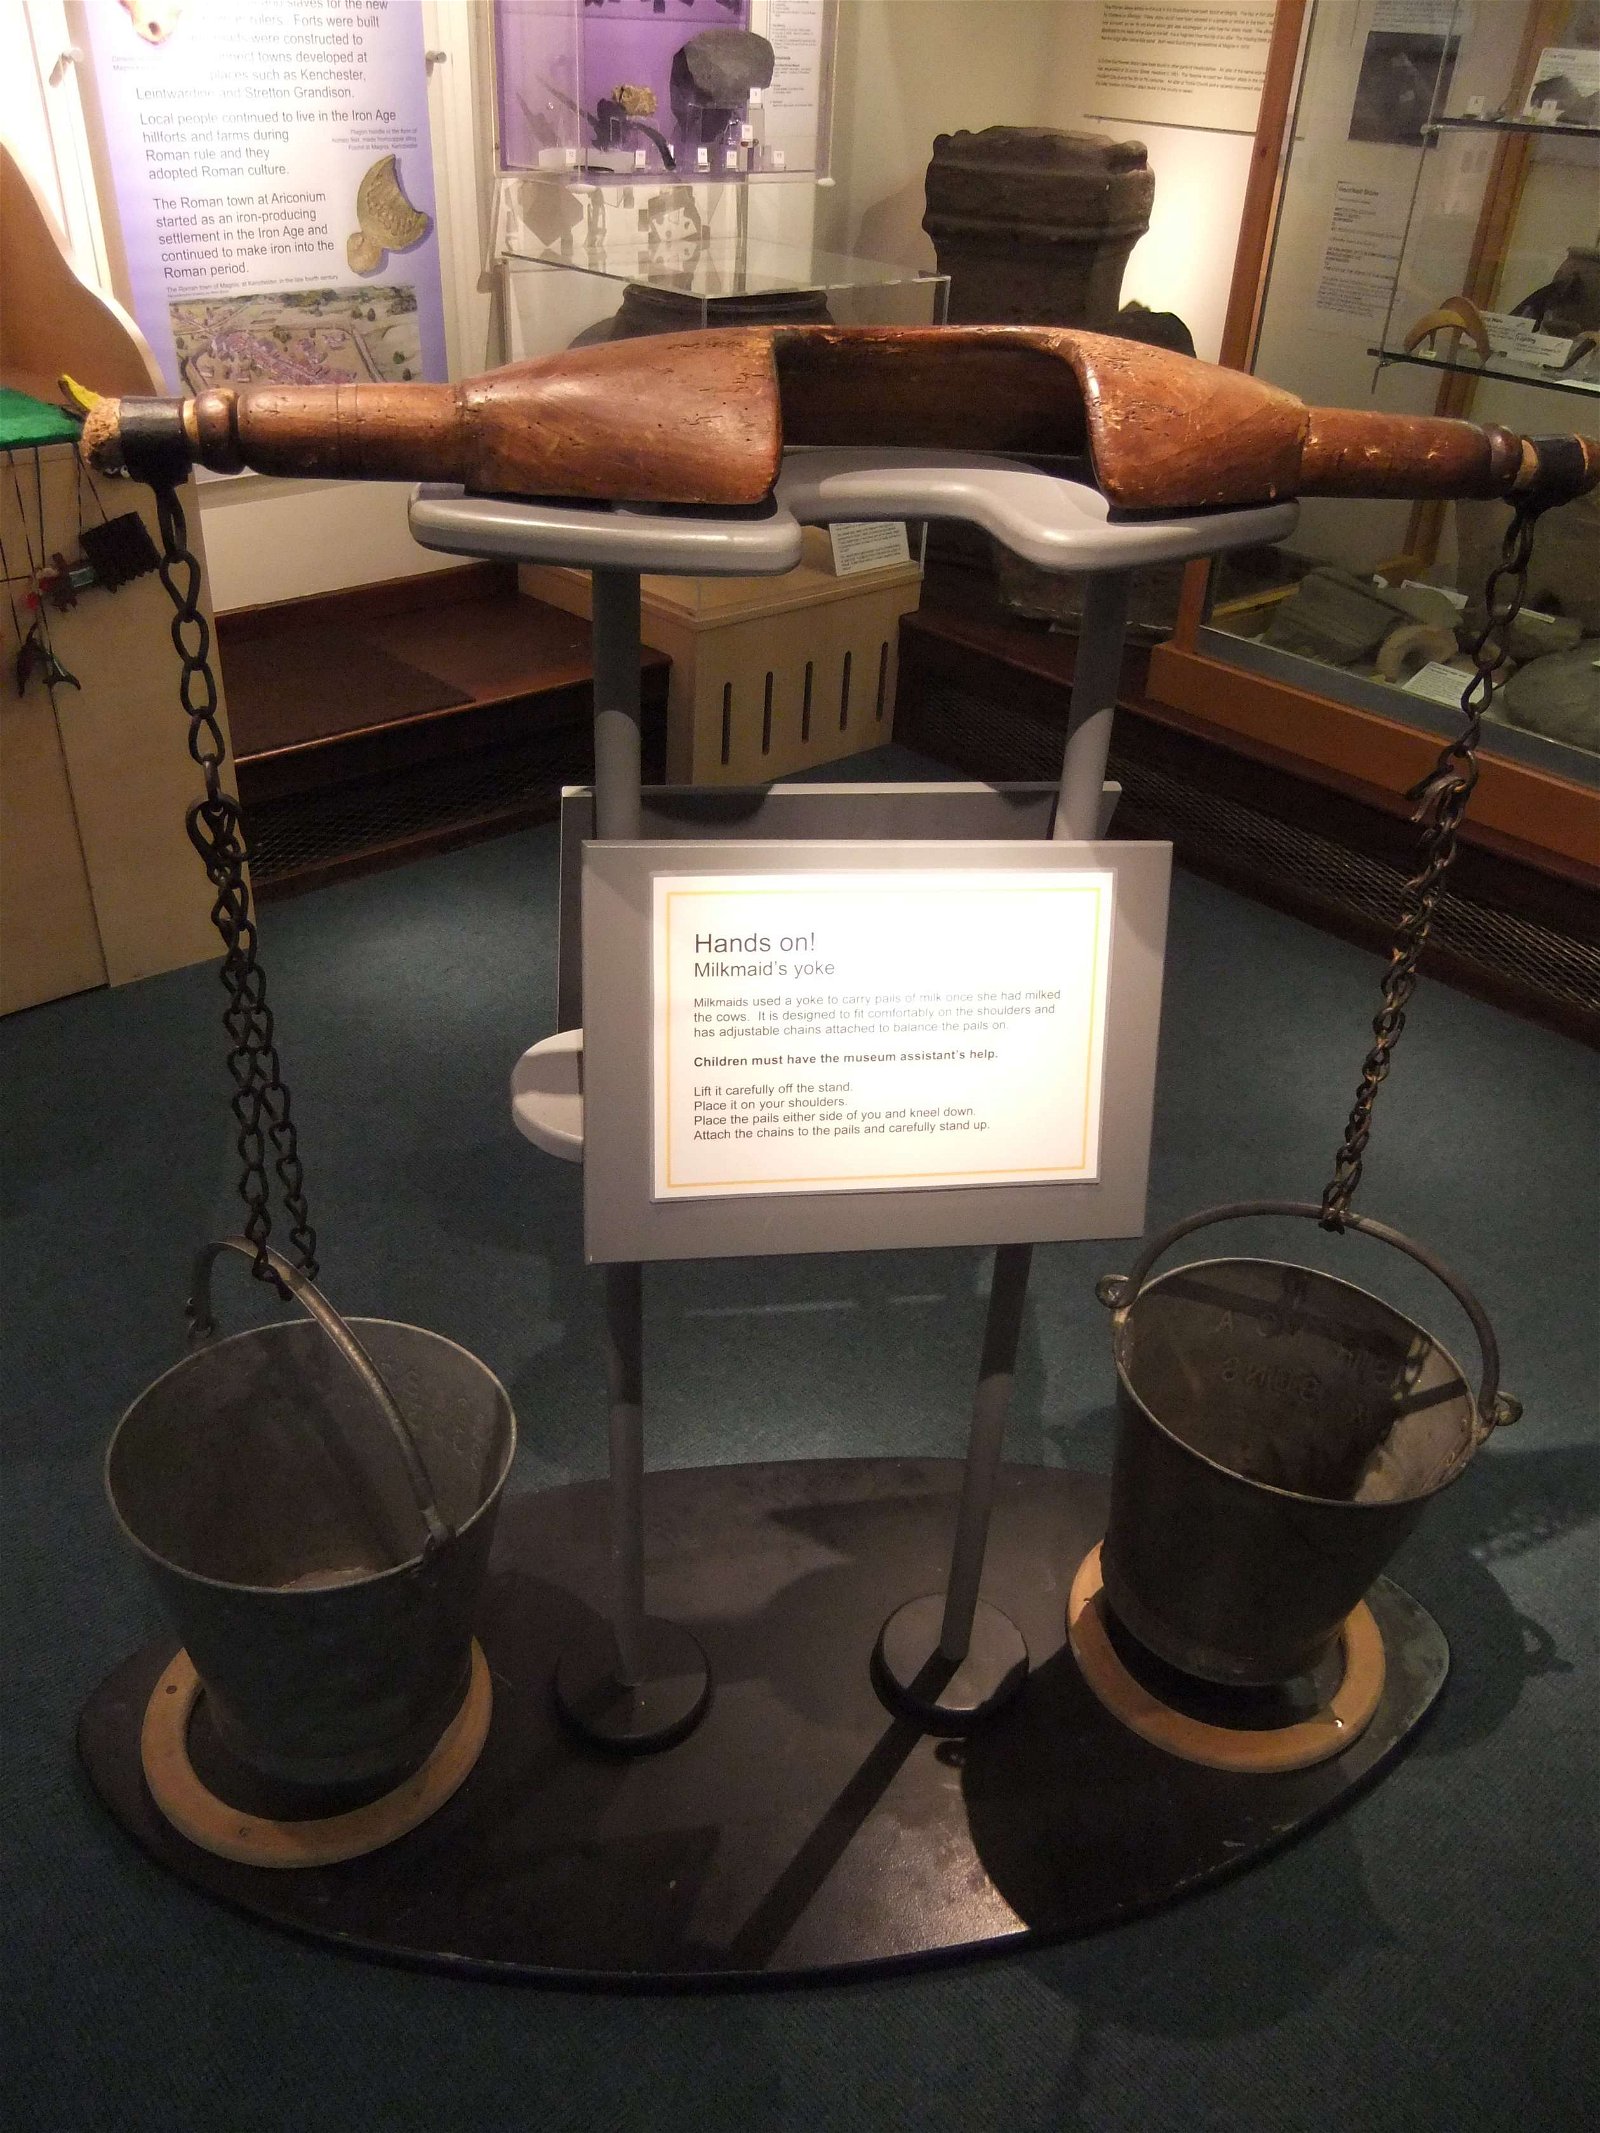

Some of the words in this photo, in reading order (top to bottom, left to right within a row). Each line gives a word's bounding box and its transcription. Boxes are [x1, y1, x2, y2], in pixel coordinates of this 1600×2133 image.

[345, 0, 362, 9] the
[366, 0, 388, 10] new
[294, 15, 322, 27] Forts
[327, 18, 353, 28] were
[357, 16, 379, 28] built
[284, 33, 349, 45] constructed
[353, 34, 363, 46] to
[258, 52, 292, 63] towns
[296, 52, 354, 64] developed
[357, 52, 368, 64] at
[252, 70, 280, 80] such
[284, 72, 297, 80] as
[301, 69, 366, 82] Kenchester,
[246, 87, 290, 98] Stretton
[294, 86, 354, 99] Grandison.
[140, 113, 174, 126] Local
[178, 114, 218, 128] people
[222, 111, 278, 124] continued
[282, 112, 293, 123] to
[296, 110, 315, 122] live
[318, 110, 328, 122] in
[332, 110, 348, 121] the
[352, 110, 372, 121] Iron
[376, 110, 396, 123] Age
[143, 131, 186, 144] hillforts
[191, 131, 213, 142] and
[217, 130, 250, 142] farms
[253, 130, 289, 143] during
[146, 150, 190, 162] Roman
[194, 149, 216, 160] rule
[220, 148, 242, 160] and
[246, 148, 270, 161] they
[148, 167, 198, 182] adopted
[202, 166, 244, 178] Roman
[248, 164, 290, 176] culture.
[153, 198, 177, 210] The
[181, 196, 224, 209] Roman
[227, 195, 254, 207] town
[258, 194, 269, 205] at
[272, 191, 326, 204] Ariconium
[156, 215, 198, 228] started
[202, 214, 215, 224] as
[219, 213, 233, 224] an
[236, 210, 316, 223] iron-producing
[159, 231, 221, 245] settlement
[224, 230, 234, 242] in
[238, 229, 255, 240] the
[259, 227, 280, 238] Iron
[284, 225, 304, 238] Age
[308, 224, 328, 236] and
[162, 248, 219, 262] continued
[222, 247, 233, 258] to
[237, 244, 268, 257] make
[271, 243, 292, 254] iron
[295, 241, 314, 252] into
[318, 240, 334, 250] the
[164, 266, 207, 279] Roman
[211, 262, 249, 277] period.
[696, 933, 771, 953] Hands
[780, 932, 815, 952] on!
[694, 961, 788, 978] Milkmaid's
[794, 960, 835, 979] yoke
[694, 998, 748, 1008] Milkmaids
[752, 996, 781, 1006] used
[796, 995, 824, 1007] yoke
[828, 996, 838, 1005] to
[842, 996, 871, 1006] carry
[876, 994, 901, 1005] pails
[905, 993, 915, 1002] of
[920, 992, 941, 1002] milk
[946, 994, 973, 1002] once
[977, 992, 997, 1002] she
[1001, 991, 1021, 1001] had
[1025, 990, 1061, 1000] milked
[694, 1012, 712, 1022] the
[716, 1012, 750, 1022] cows.
[758, 1010, 766, 1021] It
[770, 1010, 778, 1021] is
[782, 1010, 835, 1022] designed
[840, 1010, 850, 1019] to
[854, 1008, 864, 1018] fit
[868, 1007, 934, 1020] comfortably
[956, 1006, 973, 1016] the
[977, 1005, 1031, 1015] shoulders
[1034, 1004, 1055, 1014] and
[694, 1027, 715, 1037] has
[719, 1024, 780, 1039] adjustable
[784, 1024, 821, 1035] chains
[825, 1024, 875, 1034] attached
[879, 1024, 889, 1033] to
[894, 1022, 938, 1032] balance
[942, 1022, 959, 1031] the
[963, 1020, 989, 1032] pails
[992, 1020, 1008, 1030] on.
[694, 1056, 748, 1067] Children
[752, 1055, 783, 1066] must
[787, 1054, 816, 1064] have
[820, 1054, 839, 1063] the
[844, 1053, 896, 1062] museum
[900, 1050, 965, 1061] assistant's
[969, 1050, 998, 1060] help.
[694, 1086, 711, 1096] Lift
[715, 1086, 722, 1096] it
[725, 1084, 774, 1096] carefully
[778, 1084, 793, 1094] off
[796, 1083, 814, 1093] the
[818, 1082, 853, 1092] stand.
[694, 1101, 726, 1111] Place
[730, 1100, 737, 1110] it
[740, 1102, 755, 1110] on
[759, 1101, 785, 1111] your
[788, 1097, 848, 1107] shoulders.
[694, 1115, 726, 1126] Place
[730, 1114, 748, 1124] the
[752, 1113, 779, 1125] pails
[783, 1112, 816, 1122] either
[819, 1111, 843, 1122] side
[846, 1110, 858, 1120] of
[861, 1111, 881, 1122] you
[885, 1108, 906, 1119] and
[910, 1108, 940, 1118] kneel
[944, 1107, 976, 1117] down.
[694, 1130, 730, 1140] Attach
[735, 1129, 753, 1138] the
[756, 1127, 794, 1138] chains
[798, 1126, 808, 1136] to
[812, 1126, 830, 1136] the
[834, 1124, 860, 1136] pails
[864, 1124, 885, 1134] and
[888, 1122, 936, 1134] carefully
[940, 1120, 970, 1131] stand
[973, 1122, 990, 1131] up.
